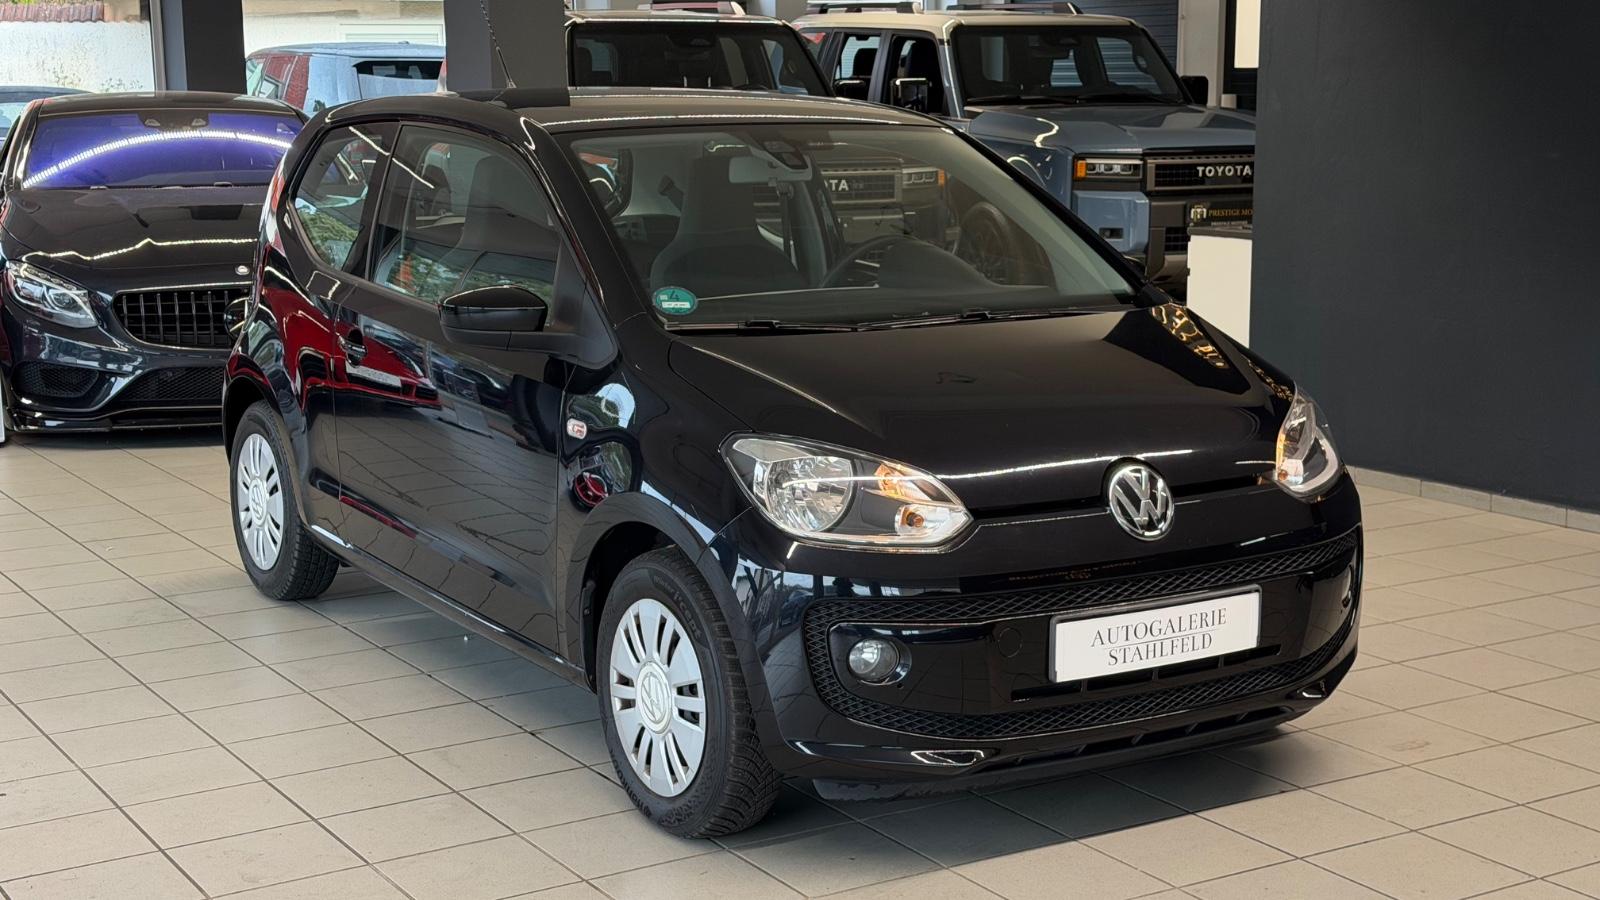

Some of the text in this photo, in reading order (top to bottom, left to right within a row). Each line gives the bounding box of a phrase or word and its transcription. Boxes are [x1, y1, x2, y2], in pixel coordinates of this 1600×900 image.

[1196, 165, 1252, 177] TOYOTA
[1208, 209, 1240, 217] PRESTIGE
[669, 290, 680, 301] 4
[1091, 607, 1227, 647] AUTOGALERIE
[1108, 632, 1212, 666] STAHLFELD
